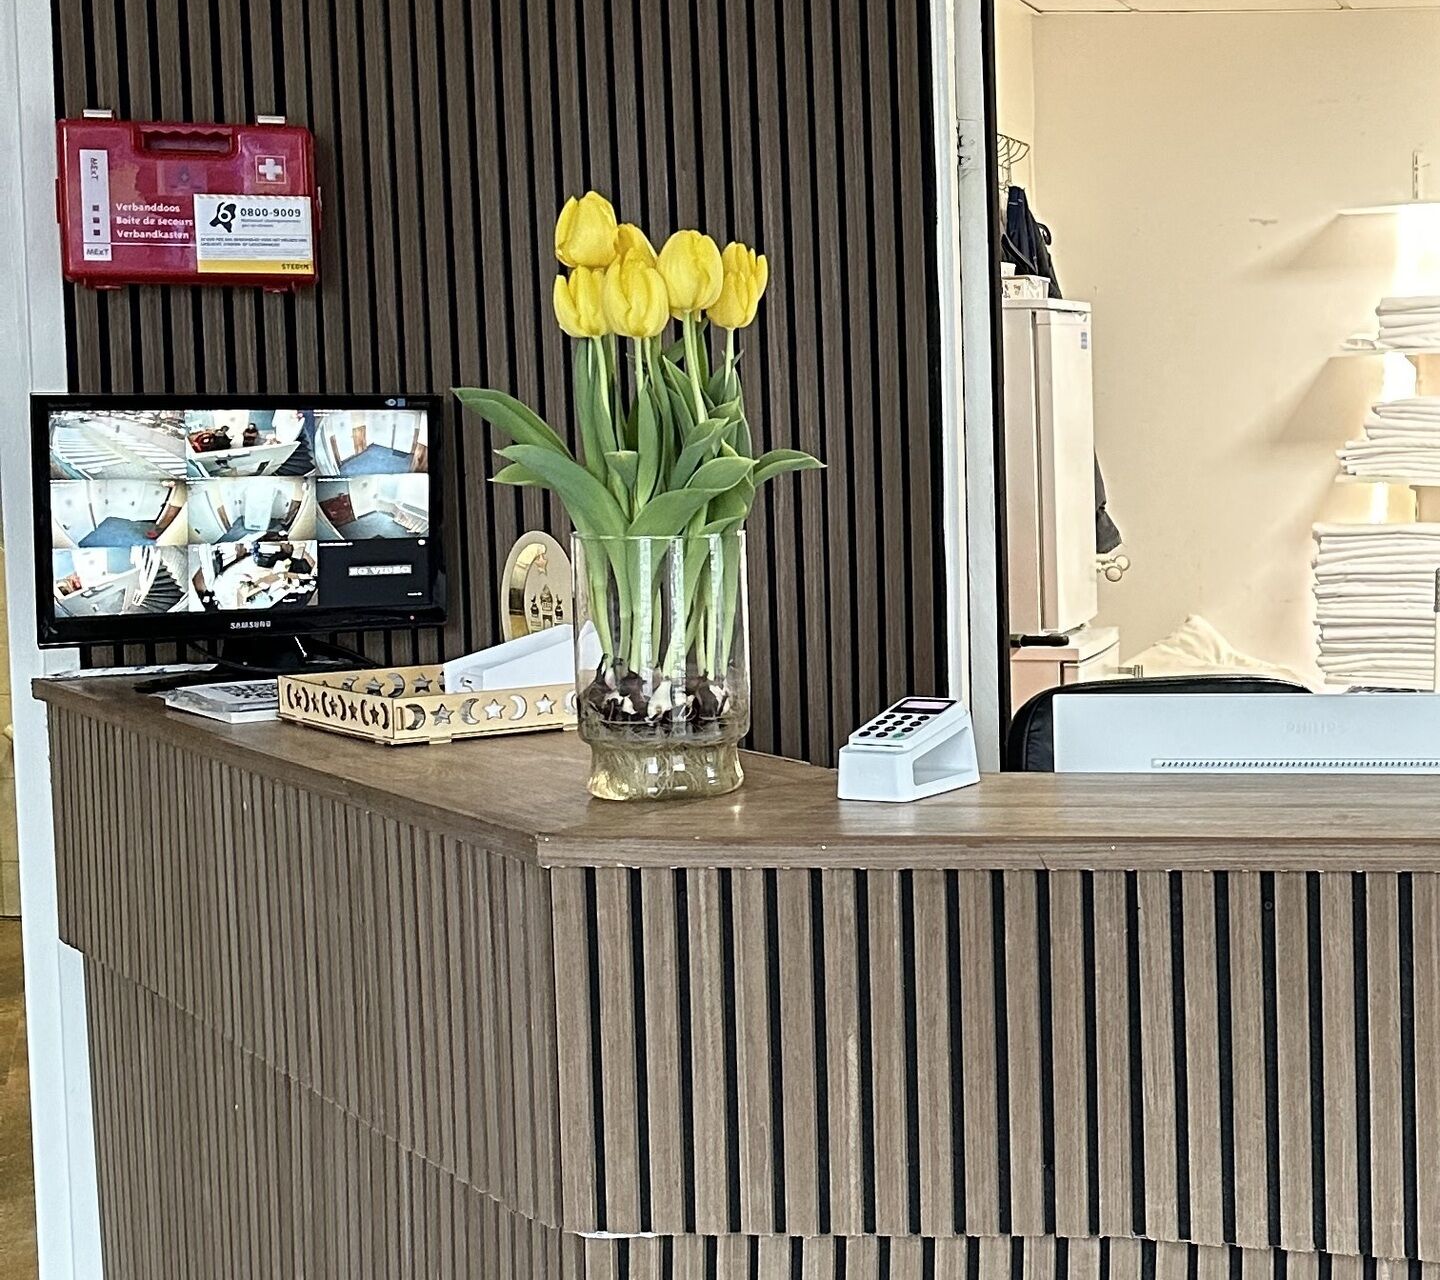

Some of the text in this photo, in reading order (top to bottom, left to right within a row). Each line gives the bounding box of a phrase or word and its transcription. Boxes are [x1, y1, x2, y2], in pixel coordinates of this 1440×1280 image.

[115, 202, 181, 213] Verbanddoos
[240, 207, 301, 218] 0800-9009
[143, 216, 156, 225] de
[157, 218, 194, 227] secours
[116, 229, 190, 239] Verbandkasten
[230, 620, 272, 630] SAMSUNG
